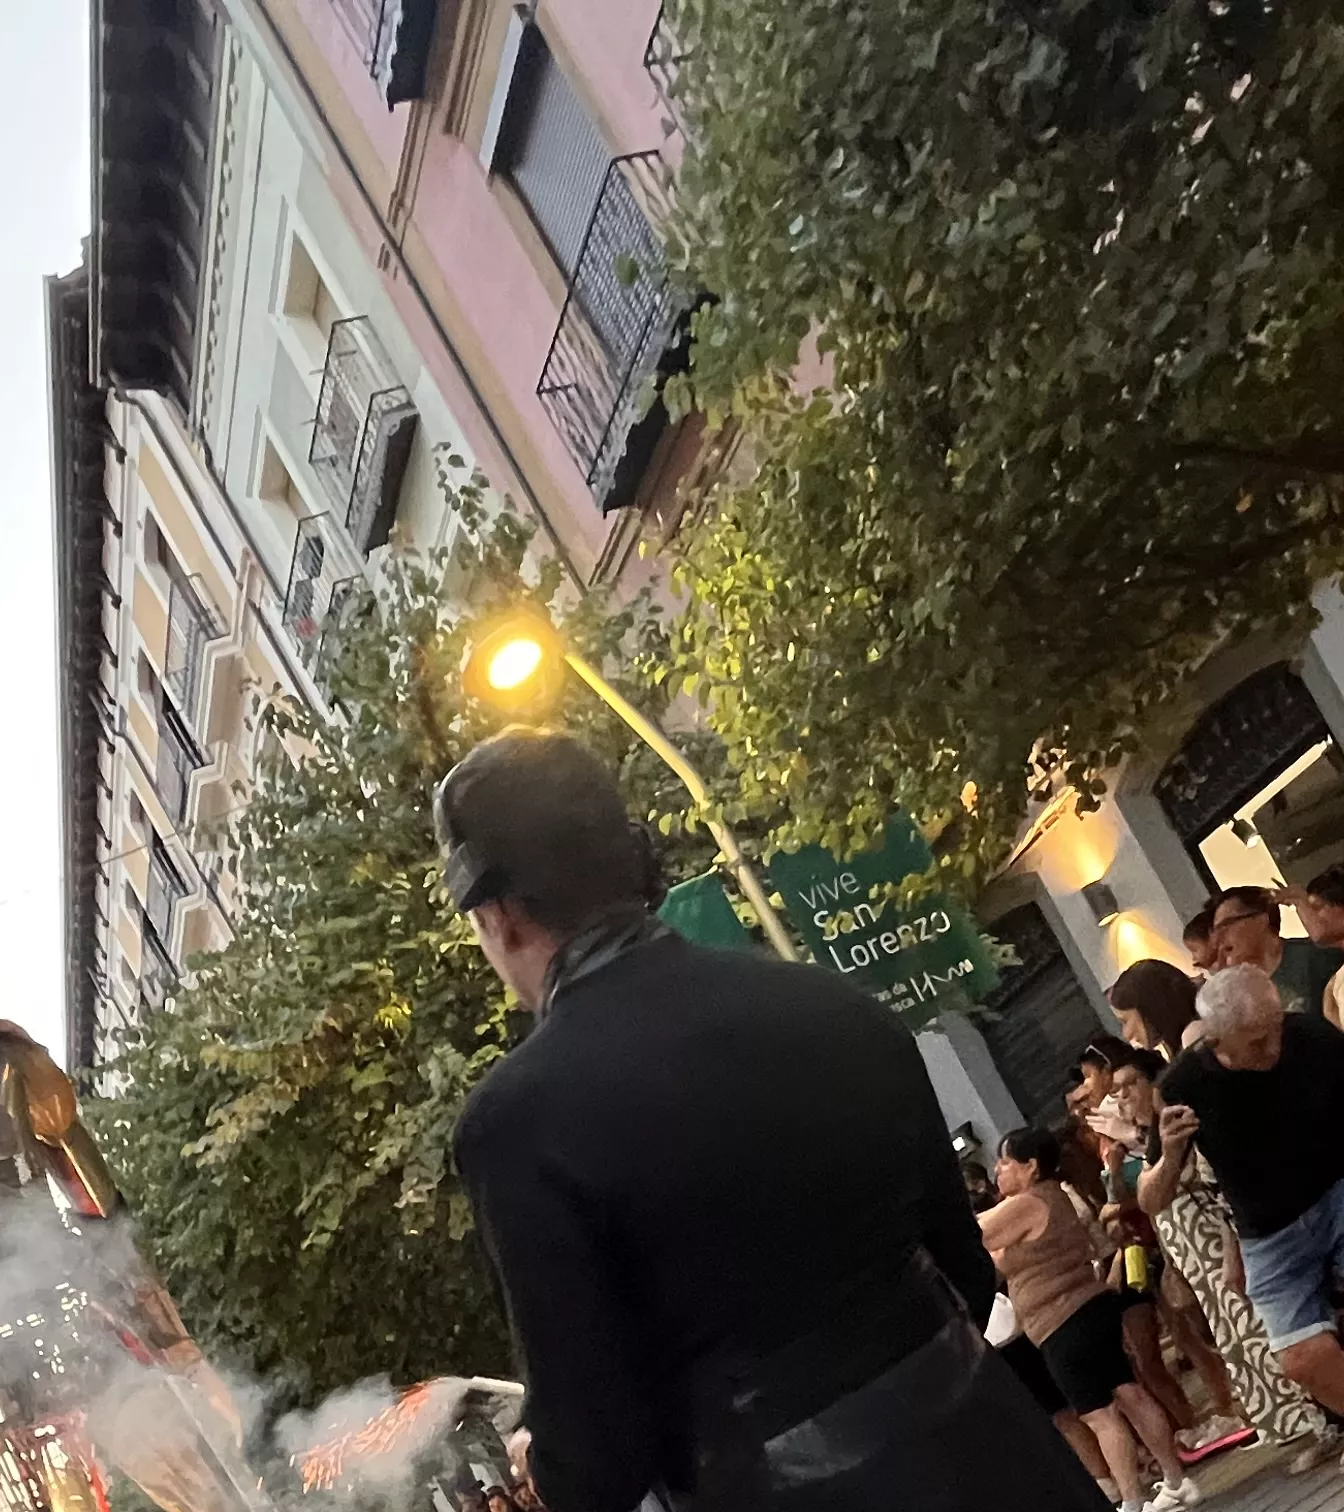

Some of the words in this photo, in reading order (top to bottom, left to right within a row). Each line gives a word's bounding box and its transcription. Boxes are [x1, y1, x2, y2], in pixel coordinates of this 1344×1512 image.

[799, 872, 860, 909] vive
[814, 903, 878, 941] Sn
[829, 911, 951, 974] Lorenzo
